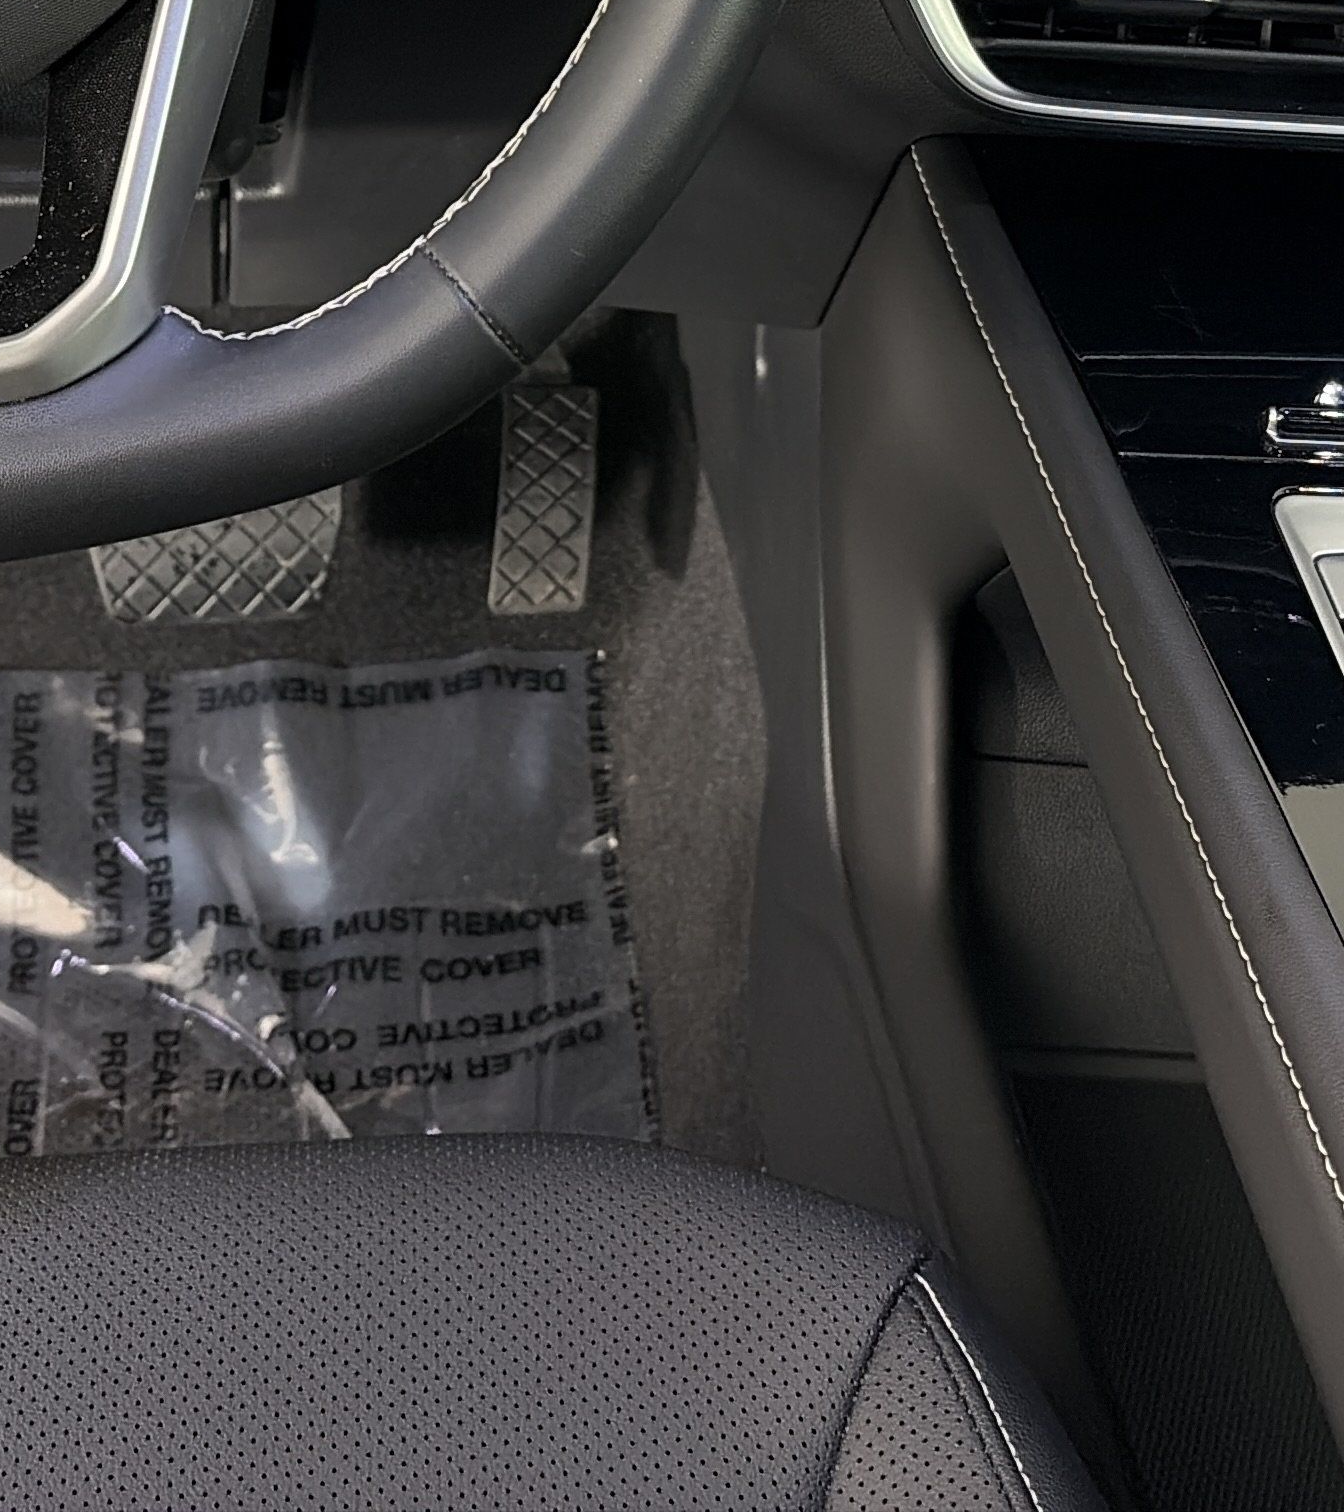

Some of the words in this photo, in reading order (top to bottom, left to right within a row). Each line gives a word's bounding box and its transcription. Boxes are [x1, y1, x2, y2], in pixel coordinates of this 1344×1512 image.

[340, 677, 434, 708] MUST
[444, 664, 567, 695] DEALER
[11, 692, 42, 797] COVER
[94, 839, 123, 949] COVER
[333, 905, 432, 940] MUST
[440, 899, 589, 937] REMOVE
[420, 946, 541, 984] COVER
